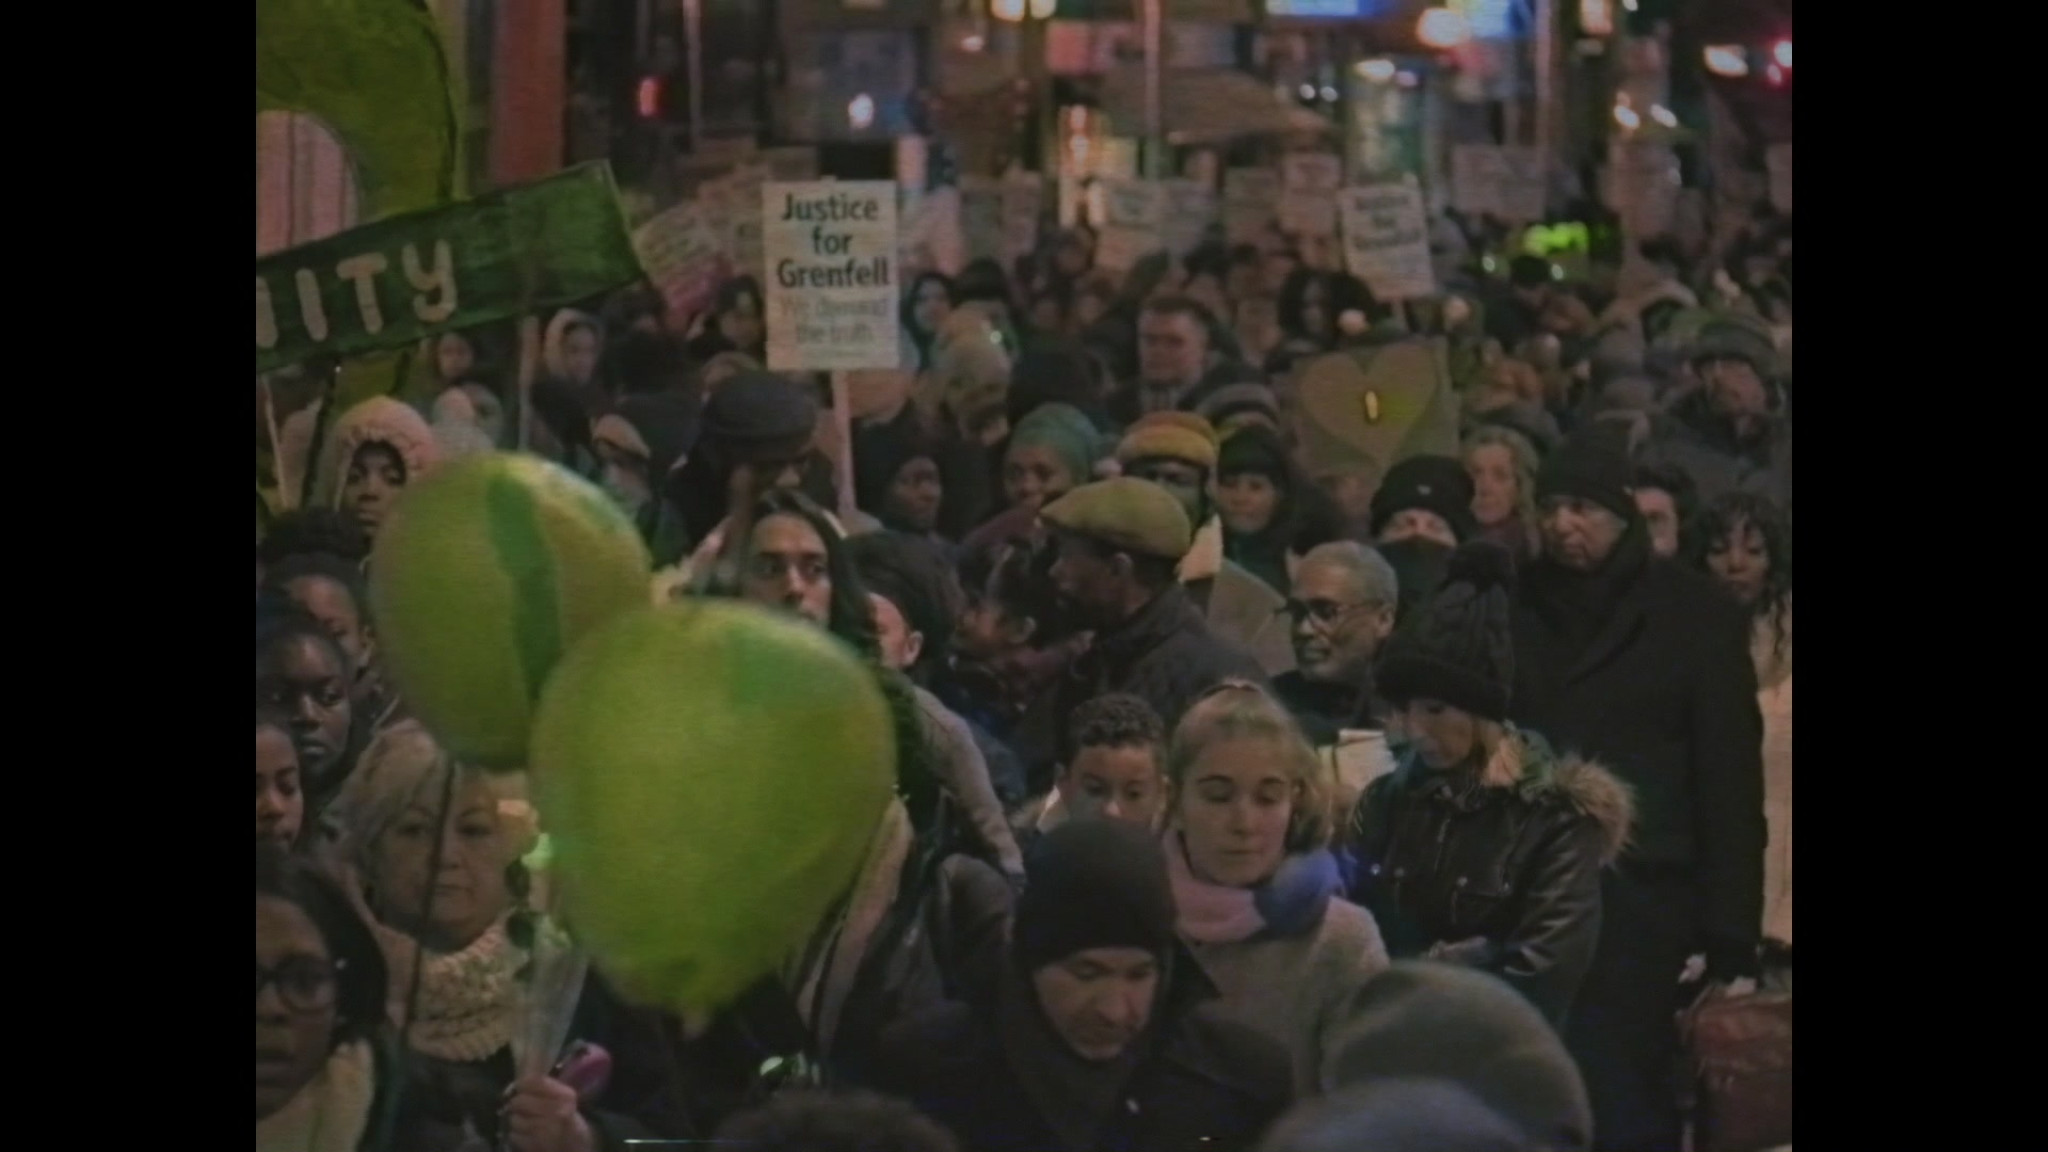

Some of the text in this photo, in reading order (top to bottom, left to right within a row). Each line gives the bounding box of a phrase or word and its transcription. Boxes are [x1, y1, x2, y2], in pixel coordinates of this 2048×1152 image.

[783, 193, 879, 221] Justice
[811, 225, 854, 254] for
[777, 257, 891, 289] Grenfell
